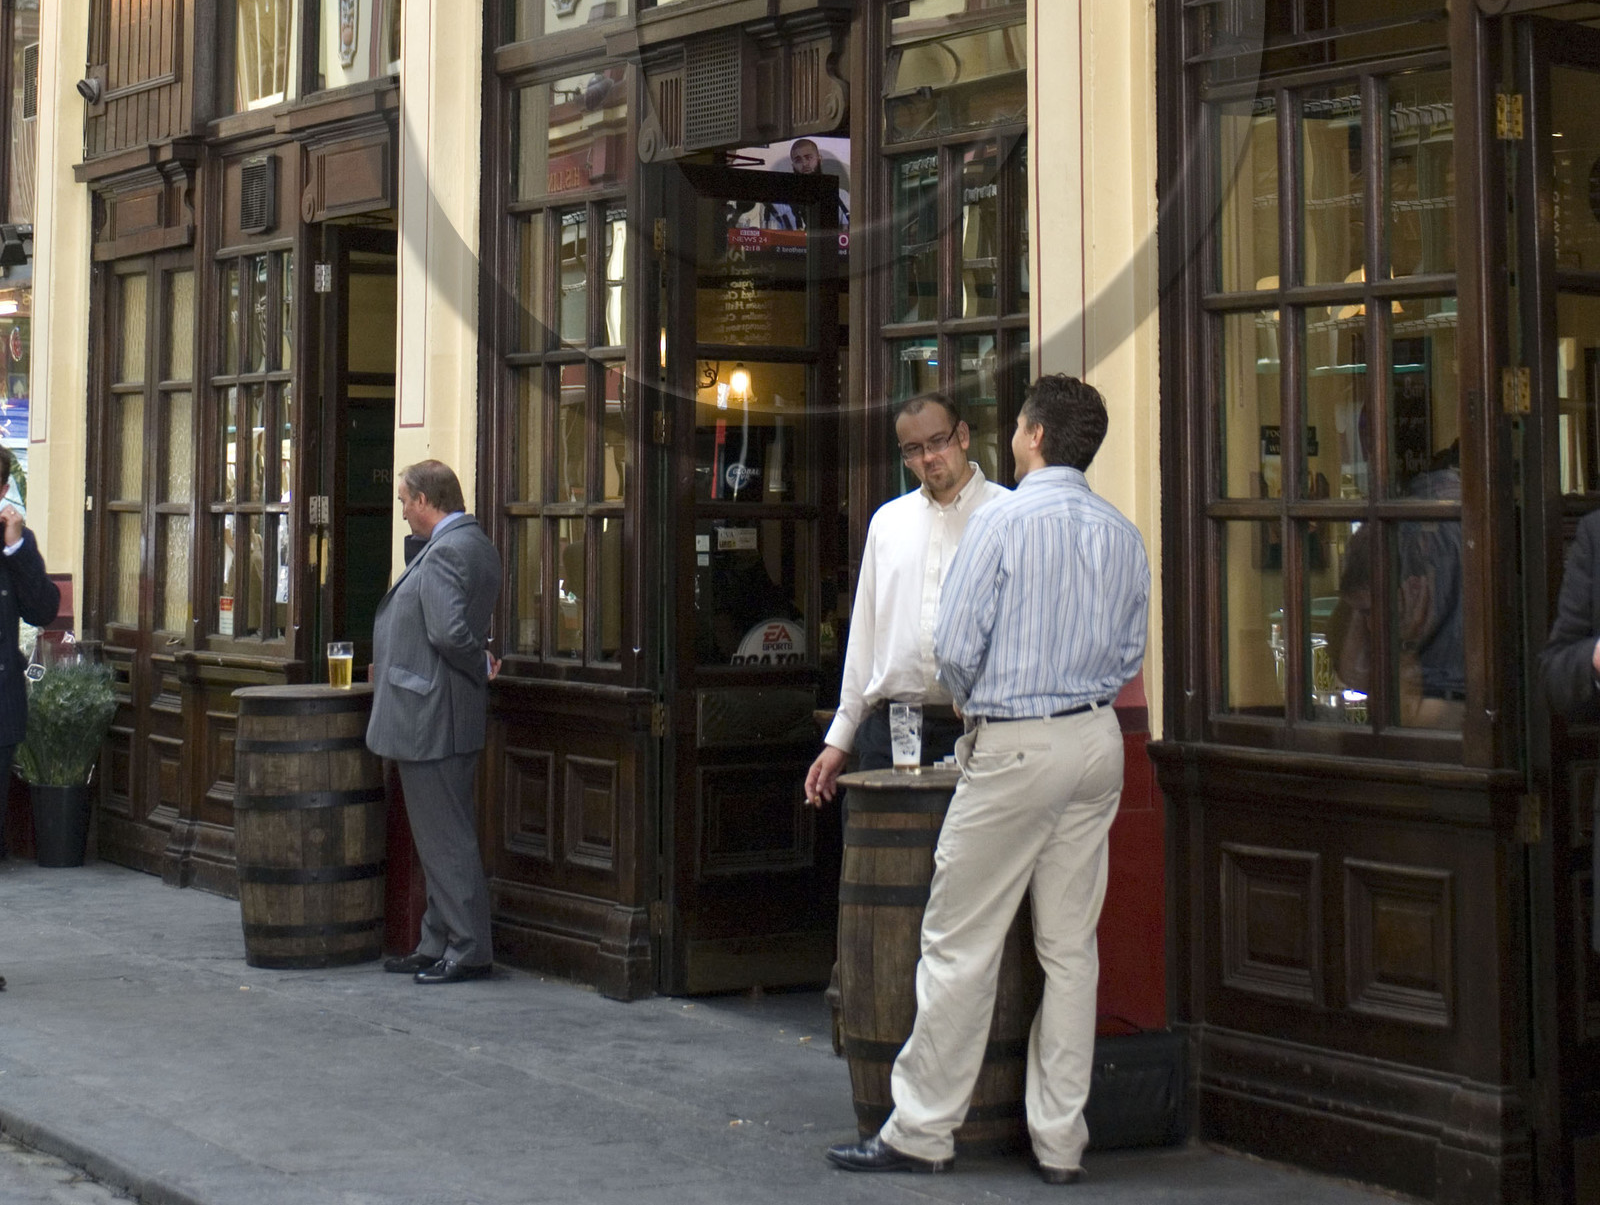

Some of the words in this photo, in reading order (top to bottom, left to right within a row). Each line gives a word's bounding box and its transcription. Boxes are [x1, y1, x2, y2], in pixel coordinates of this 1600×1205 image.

[758, 236, 768, 244] 24
[763, 624, 792, 642] EA
[763, 642, 793, 651] SPORTS
